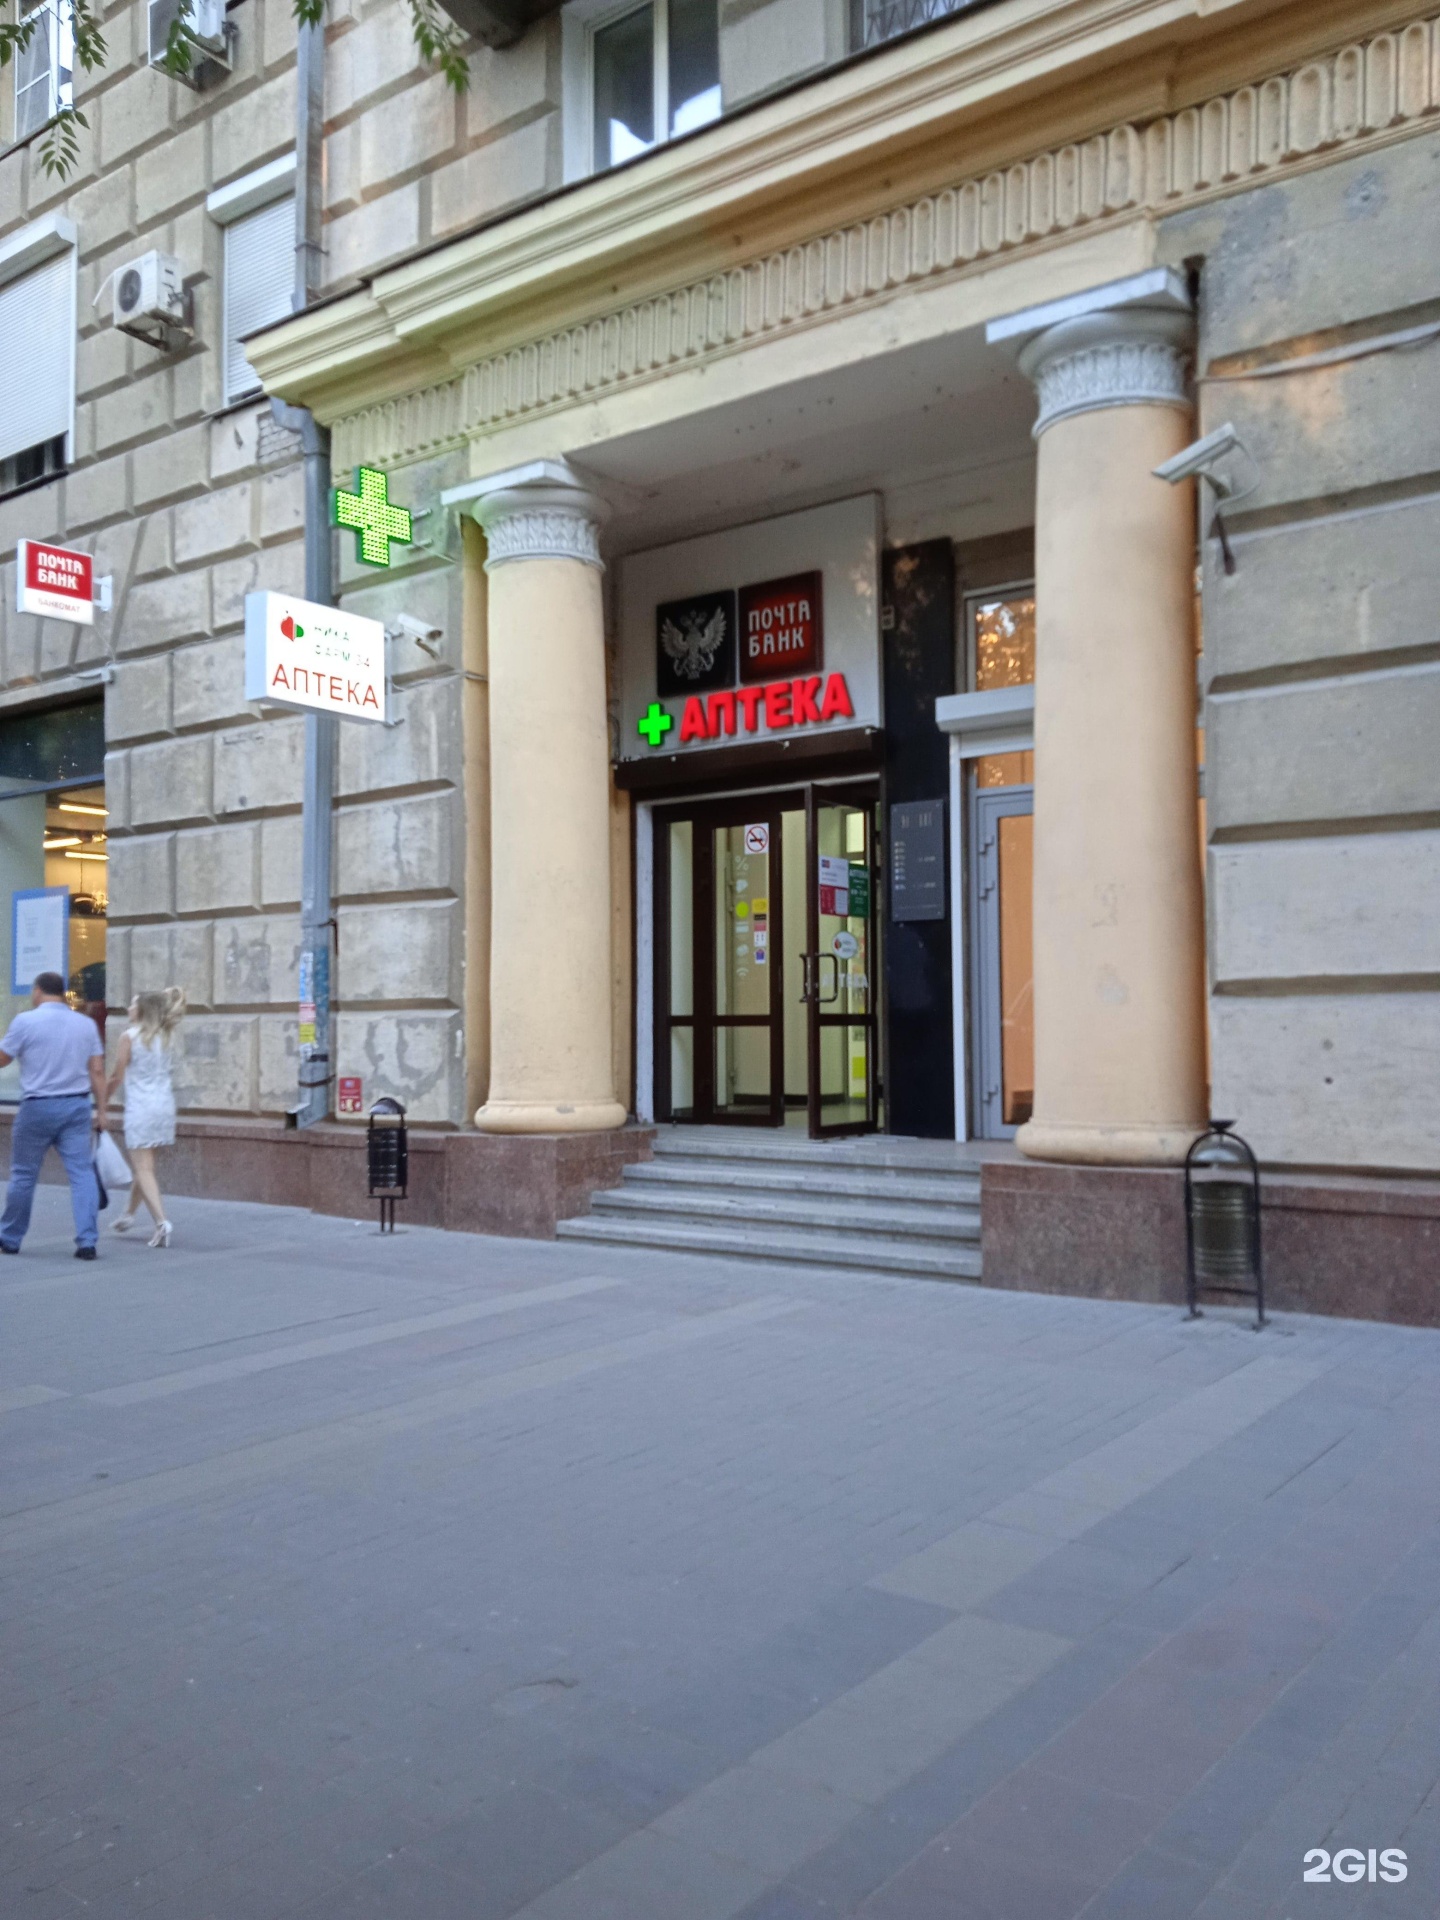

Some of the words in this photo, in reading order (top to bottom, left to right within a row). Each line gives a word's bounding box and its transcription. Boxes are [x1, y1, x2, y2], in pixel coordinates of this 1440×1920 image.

[38, 552, 84, 575] ПОЧТА
[38, 568, 79, 590] БАНК
[749, 599, 811, 632] ПОЧТА
[749, 626, 805, 658] БАНК
[272, 663, 378, 708] АПТЕКА
[680, 672, 855, 742] АПТЕКА
